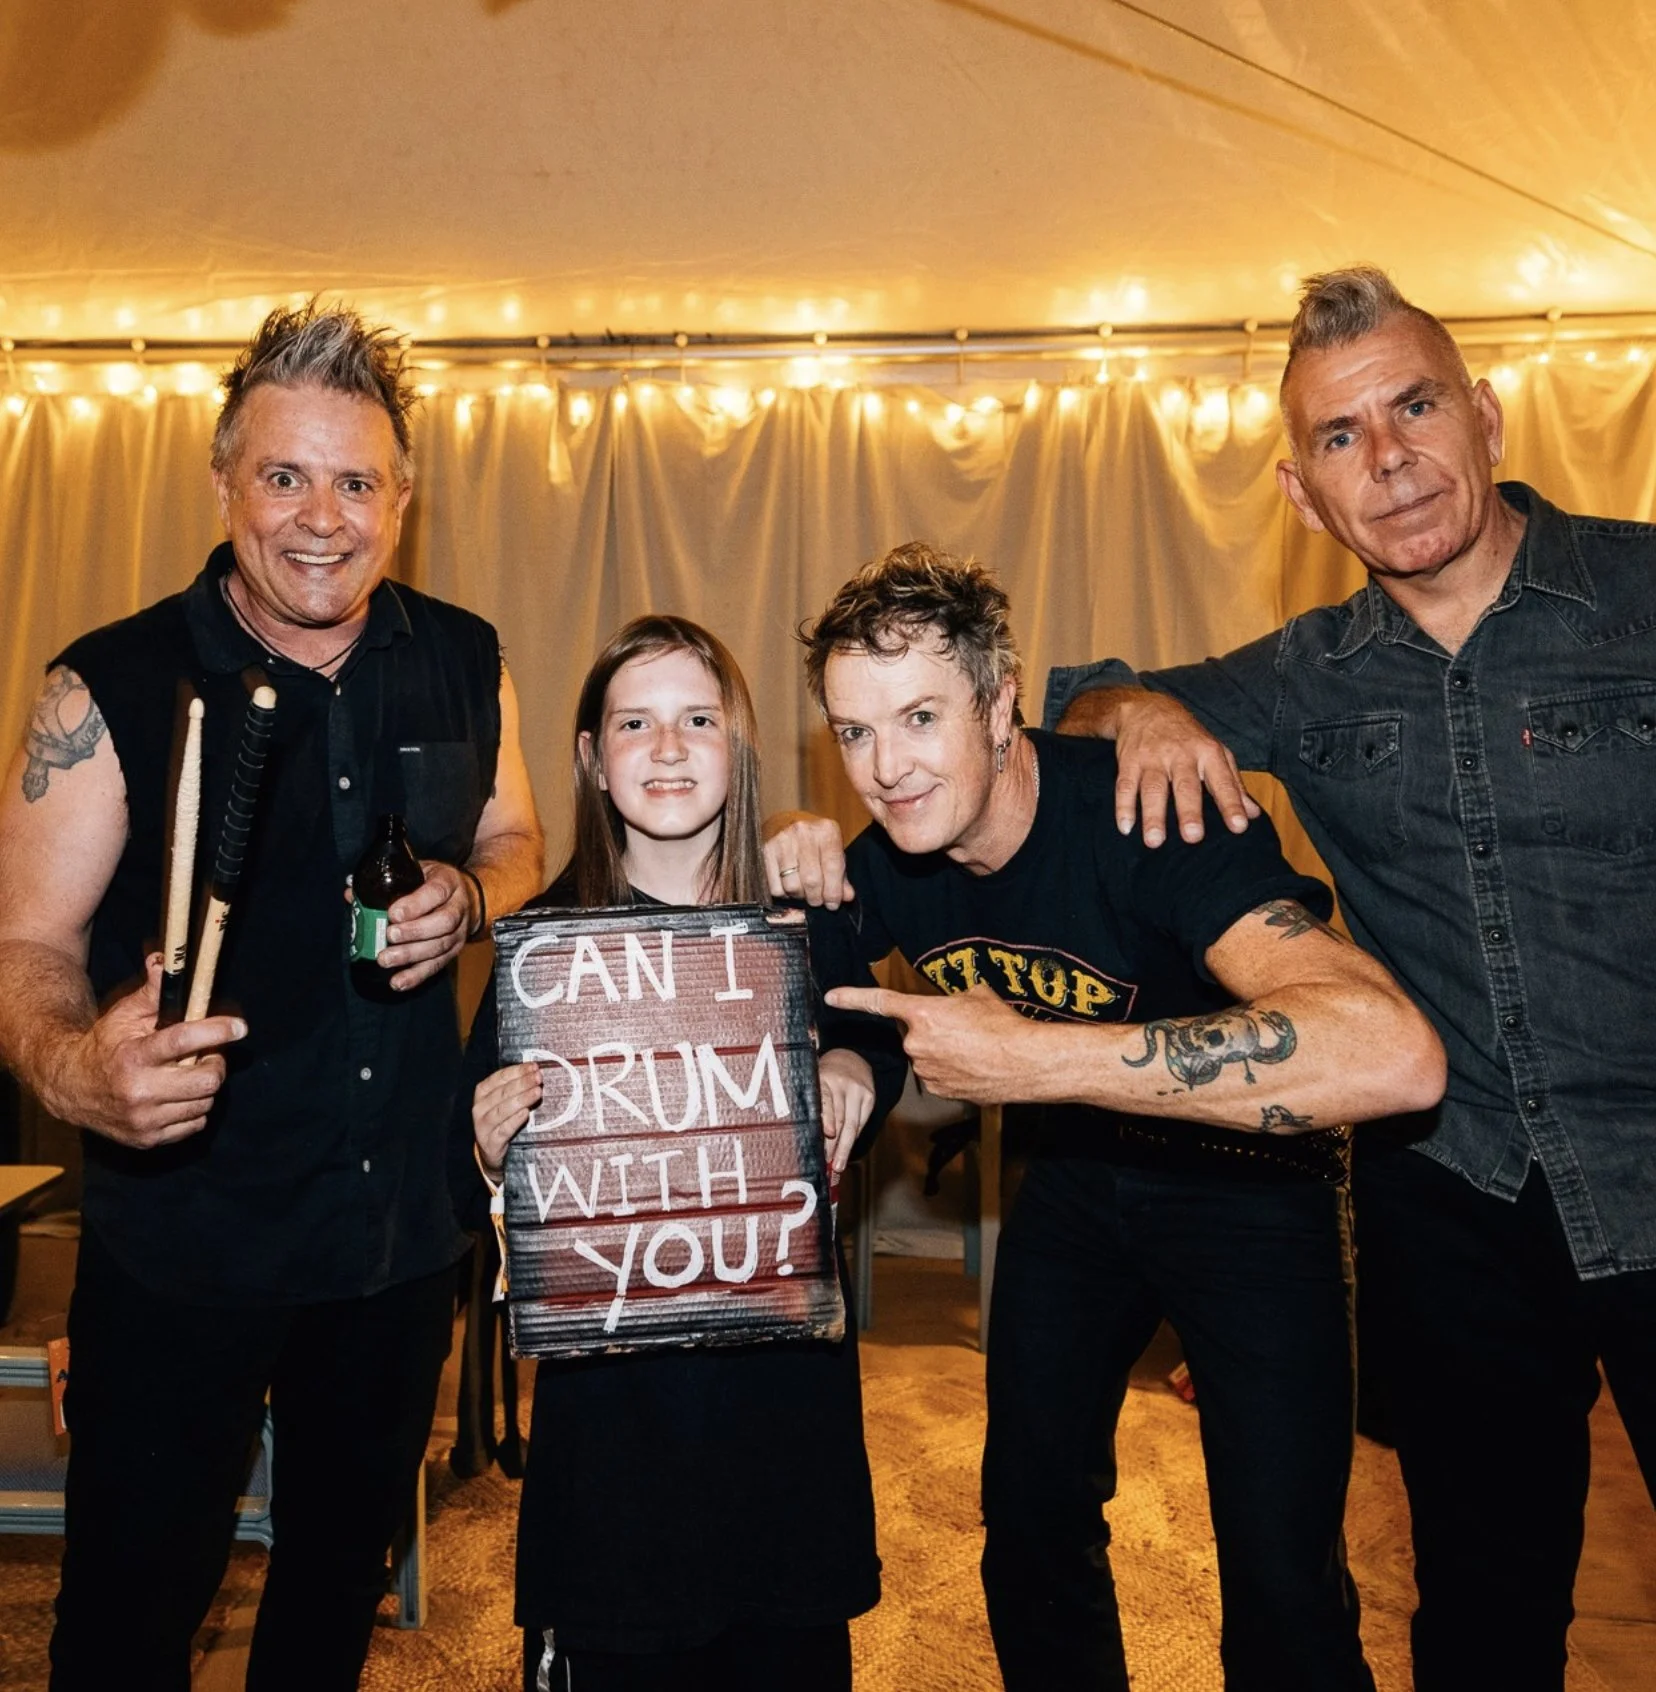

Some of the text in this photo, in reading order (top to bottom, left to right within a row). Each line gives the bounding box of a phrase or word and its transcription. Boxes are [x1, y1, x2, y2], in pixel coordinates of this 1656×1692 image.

[511, 922, 753, 1009] CAN I
[988, 947, 1117, 1017] TOP
[521, 1032, 790, 1132] DRUM
[527, 1136, 747, 1224] WITH
[573, 1180, 818, 1333] YOU?
